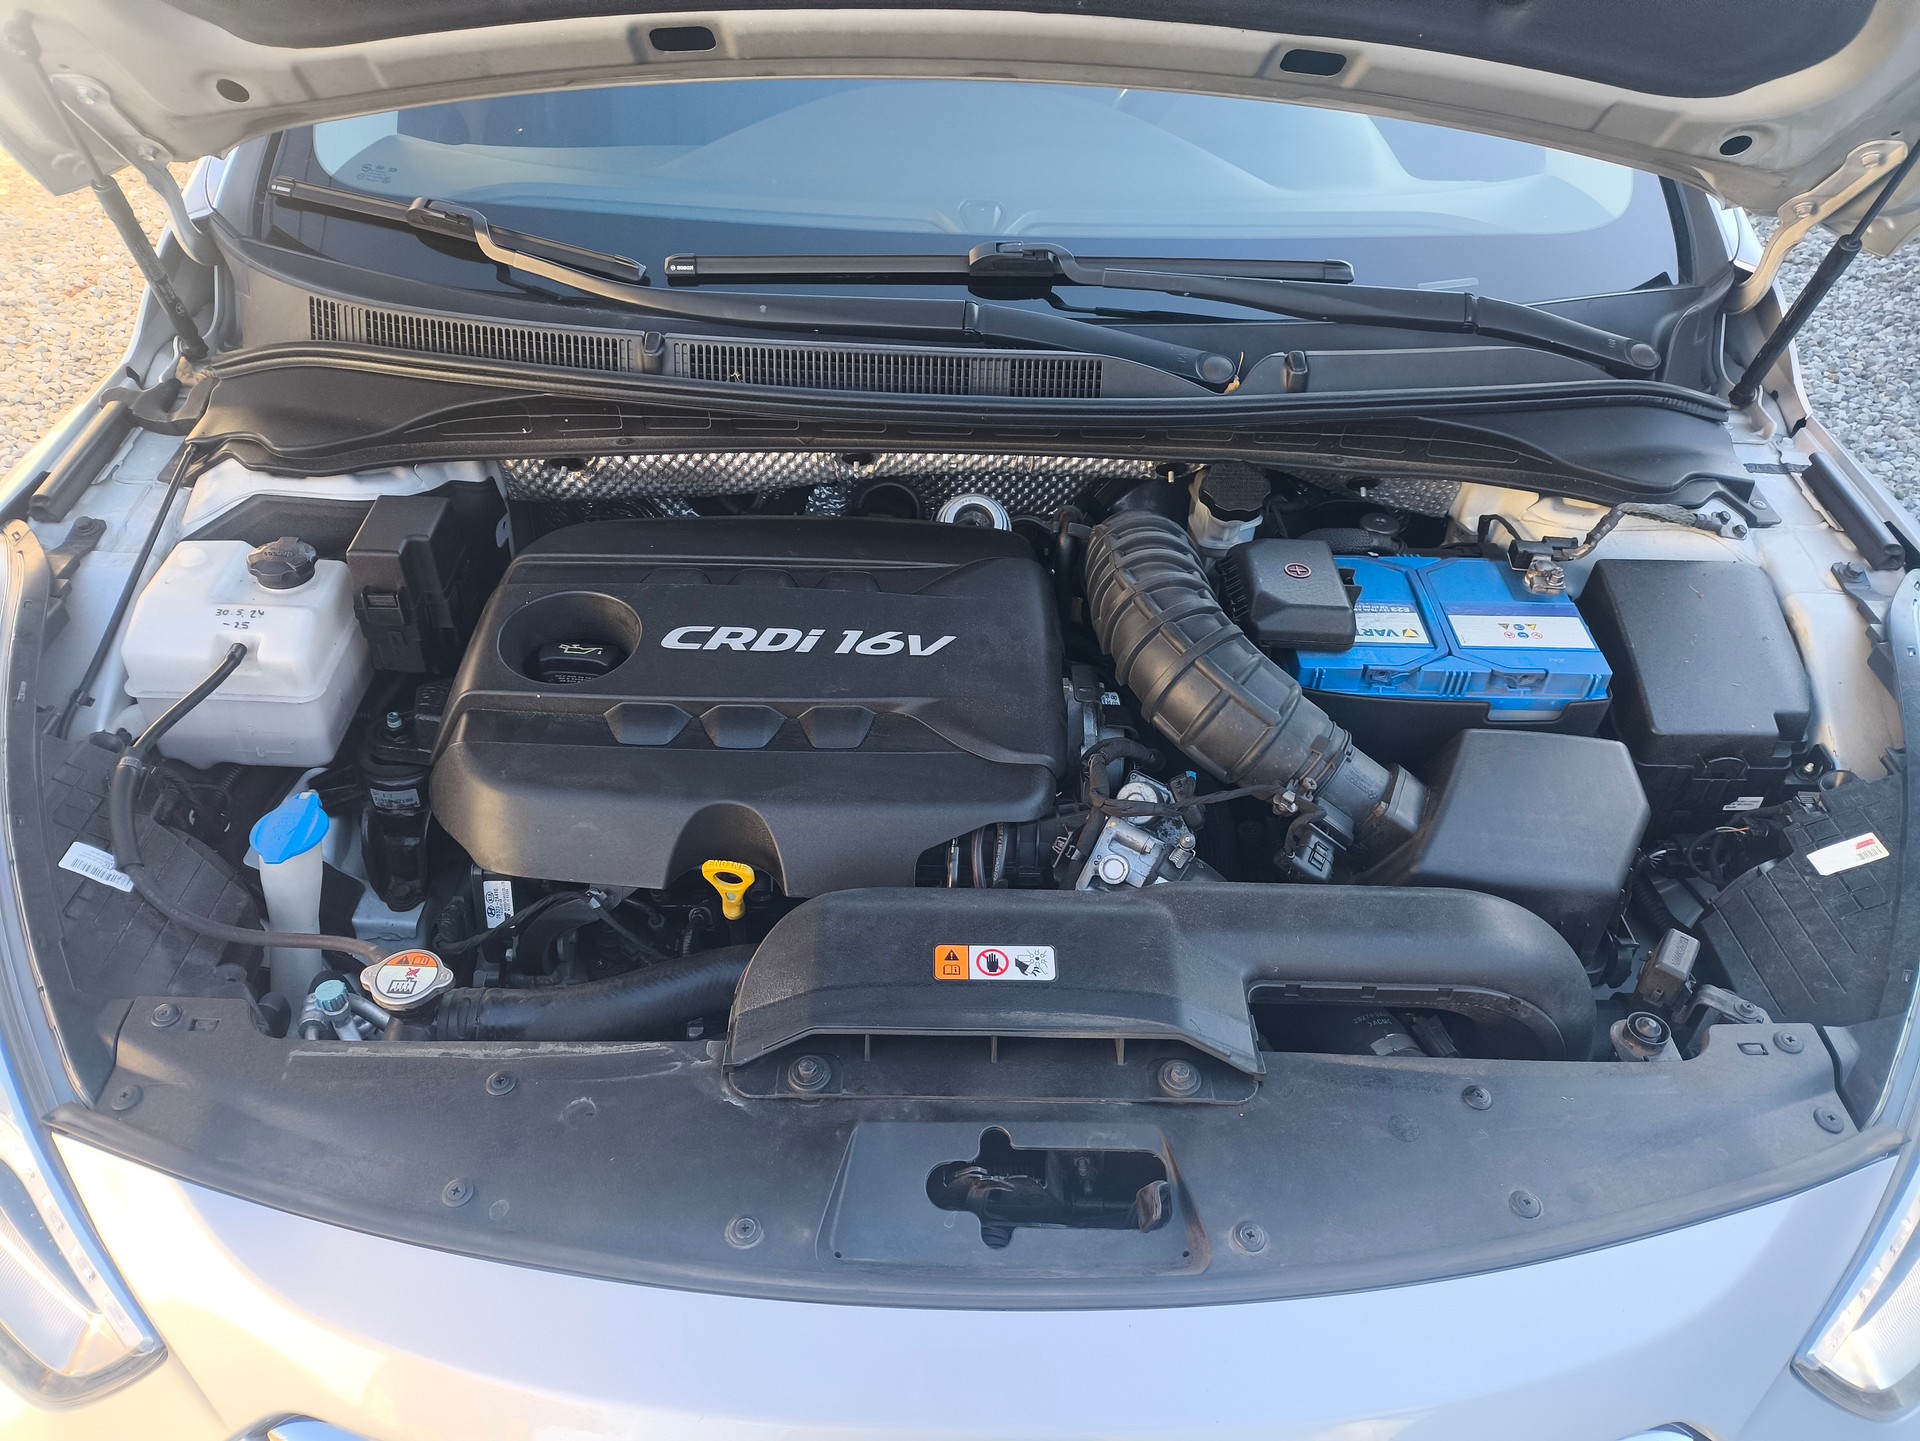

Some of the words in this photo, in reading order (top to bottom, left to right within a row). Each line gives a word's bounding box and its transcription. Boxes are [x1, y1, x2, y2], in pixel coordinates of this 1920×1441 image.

[1355, 628, 1399, 637] VART
[660, 625, 826, 653] CRDi
[834, 629, 957, 656] 16V
[708, 860, 747, 870] ENGINE
